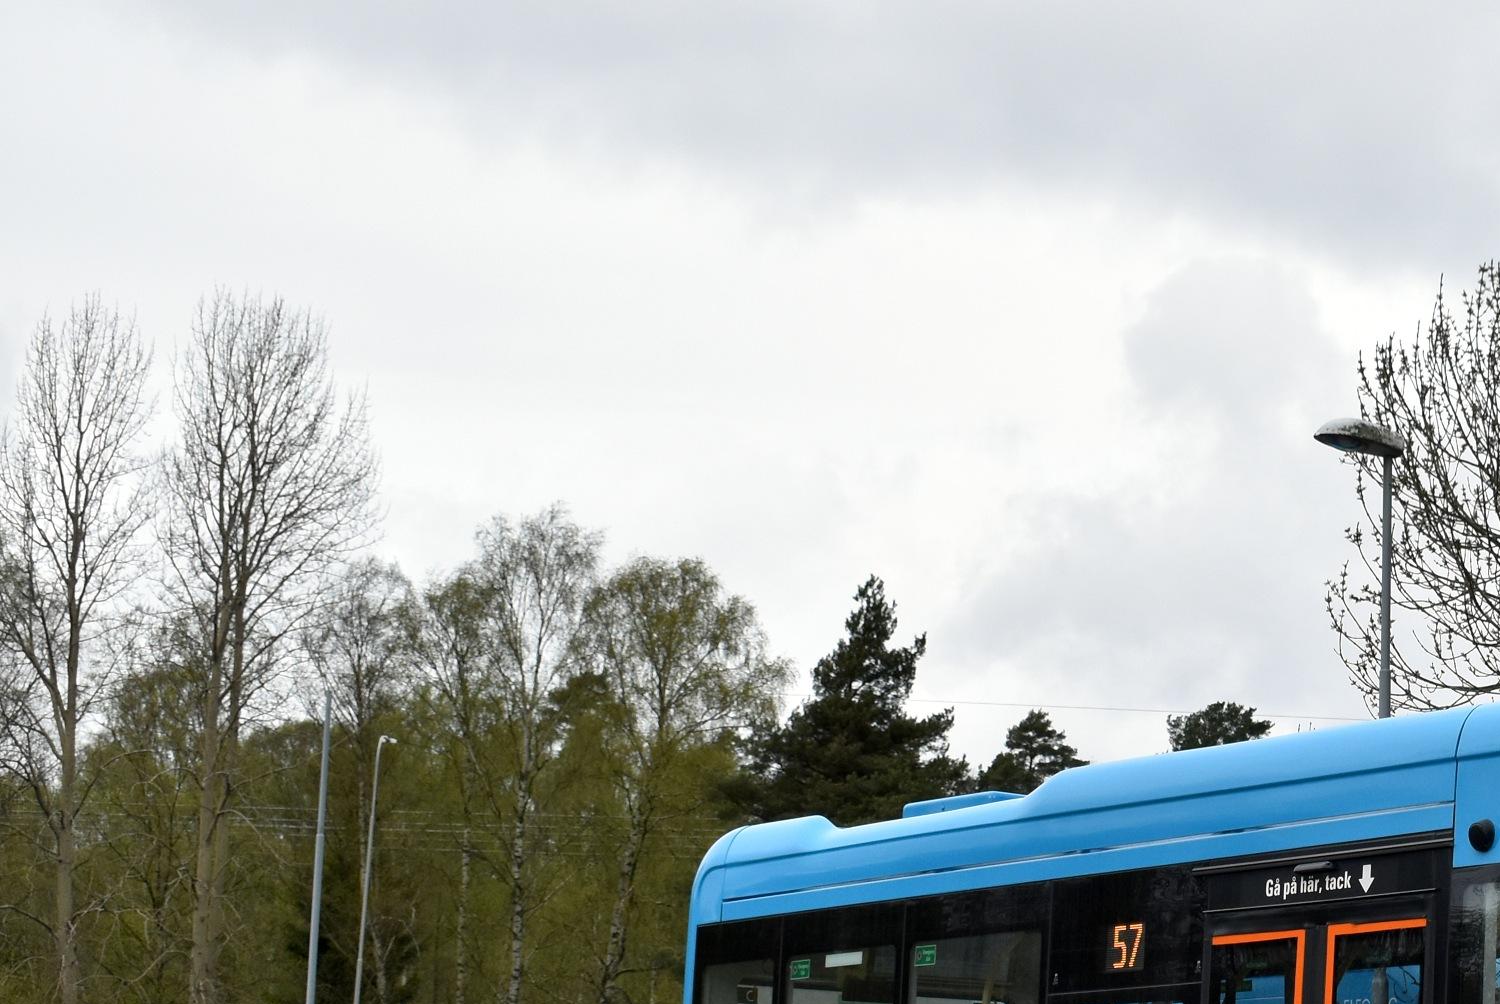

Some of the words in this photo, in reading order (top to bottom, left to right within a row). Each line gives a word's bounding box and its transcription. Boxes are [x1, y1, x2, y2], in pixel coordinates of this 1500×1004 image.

[1265, 878, 1281, 897] Gå
[1283, 876, 1297, 900] på
[1300, 875, 1322, 894] här,
[1325, 871, 1352, 890] tack
[1112, 923, 1143, 969] 57
